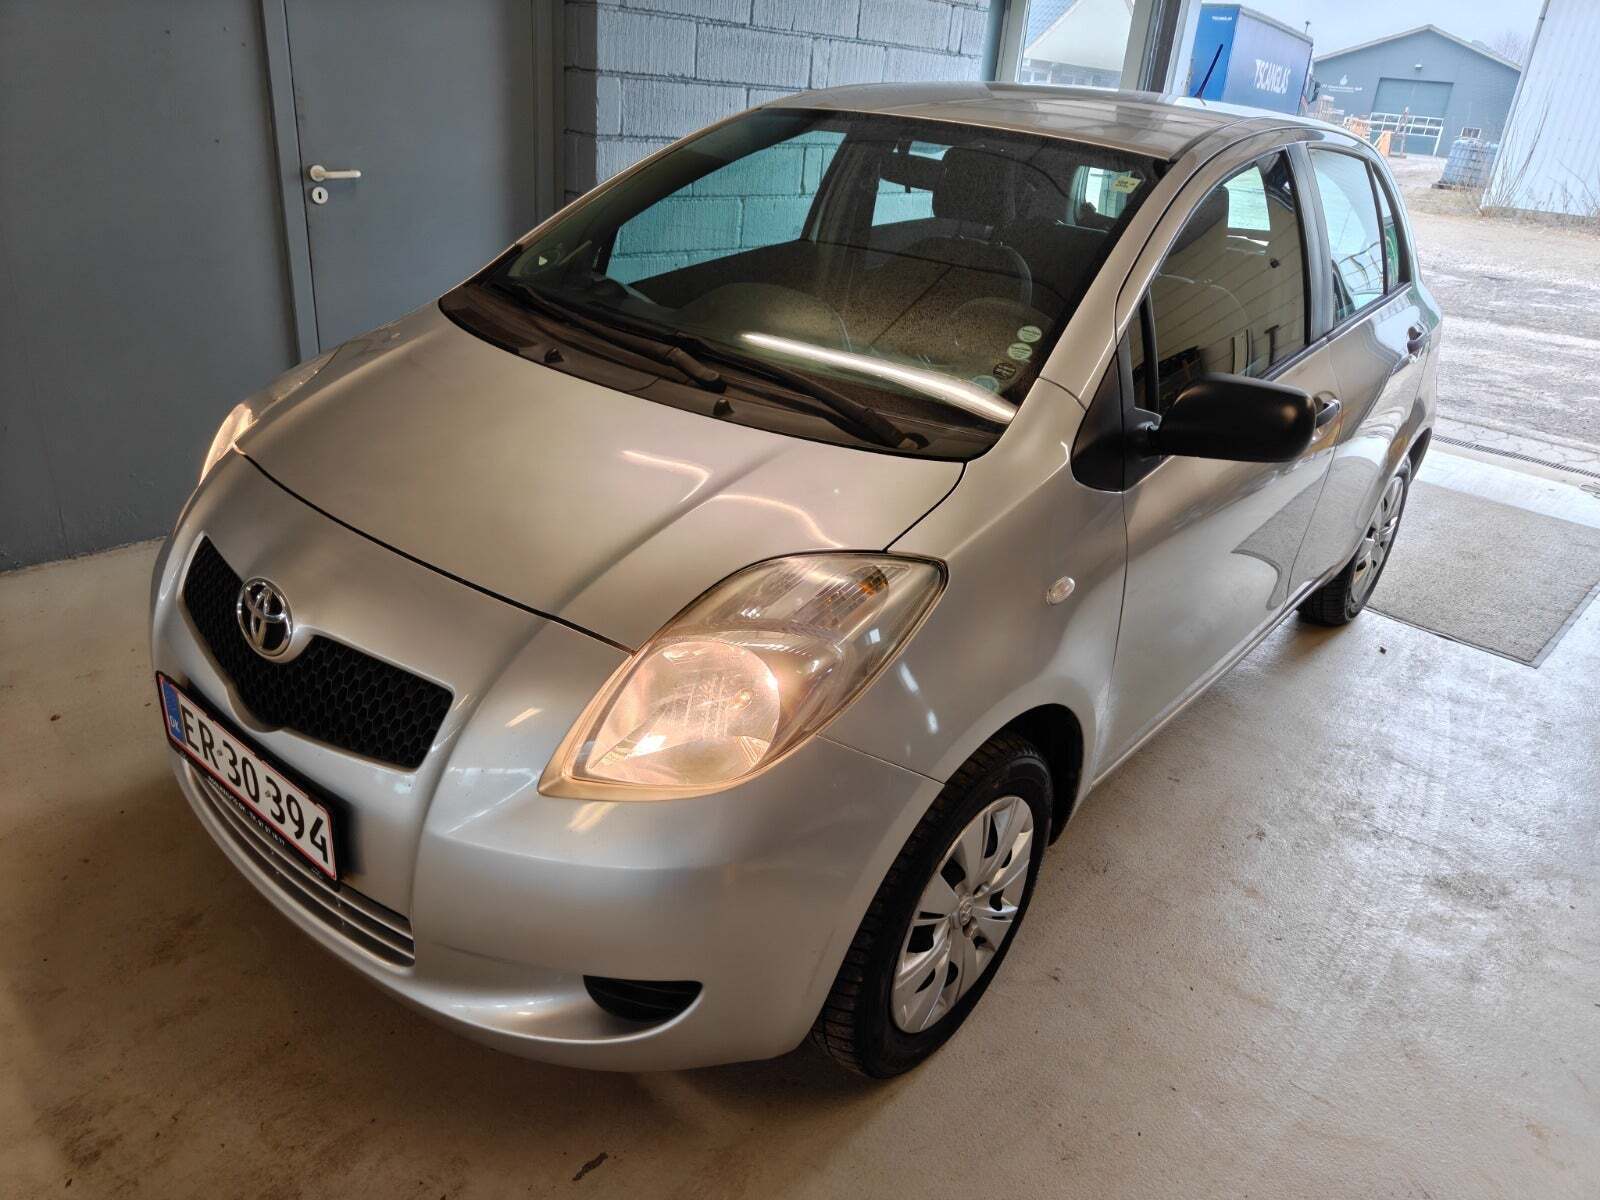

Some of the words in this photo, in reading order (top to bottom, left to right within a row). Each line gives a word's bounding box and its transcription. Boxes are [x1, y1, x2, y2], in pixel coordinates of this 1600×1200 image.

[181, 704, 220, 770] ER
[223, 740, 260, 804] 30
[266, 775, 330, 864] 394
